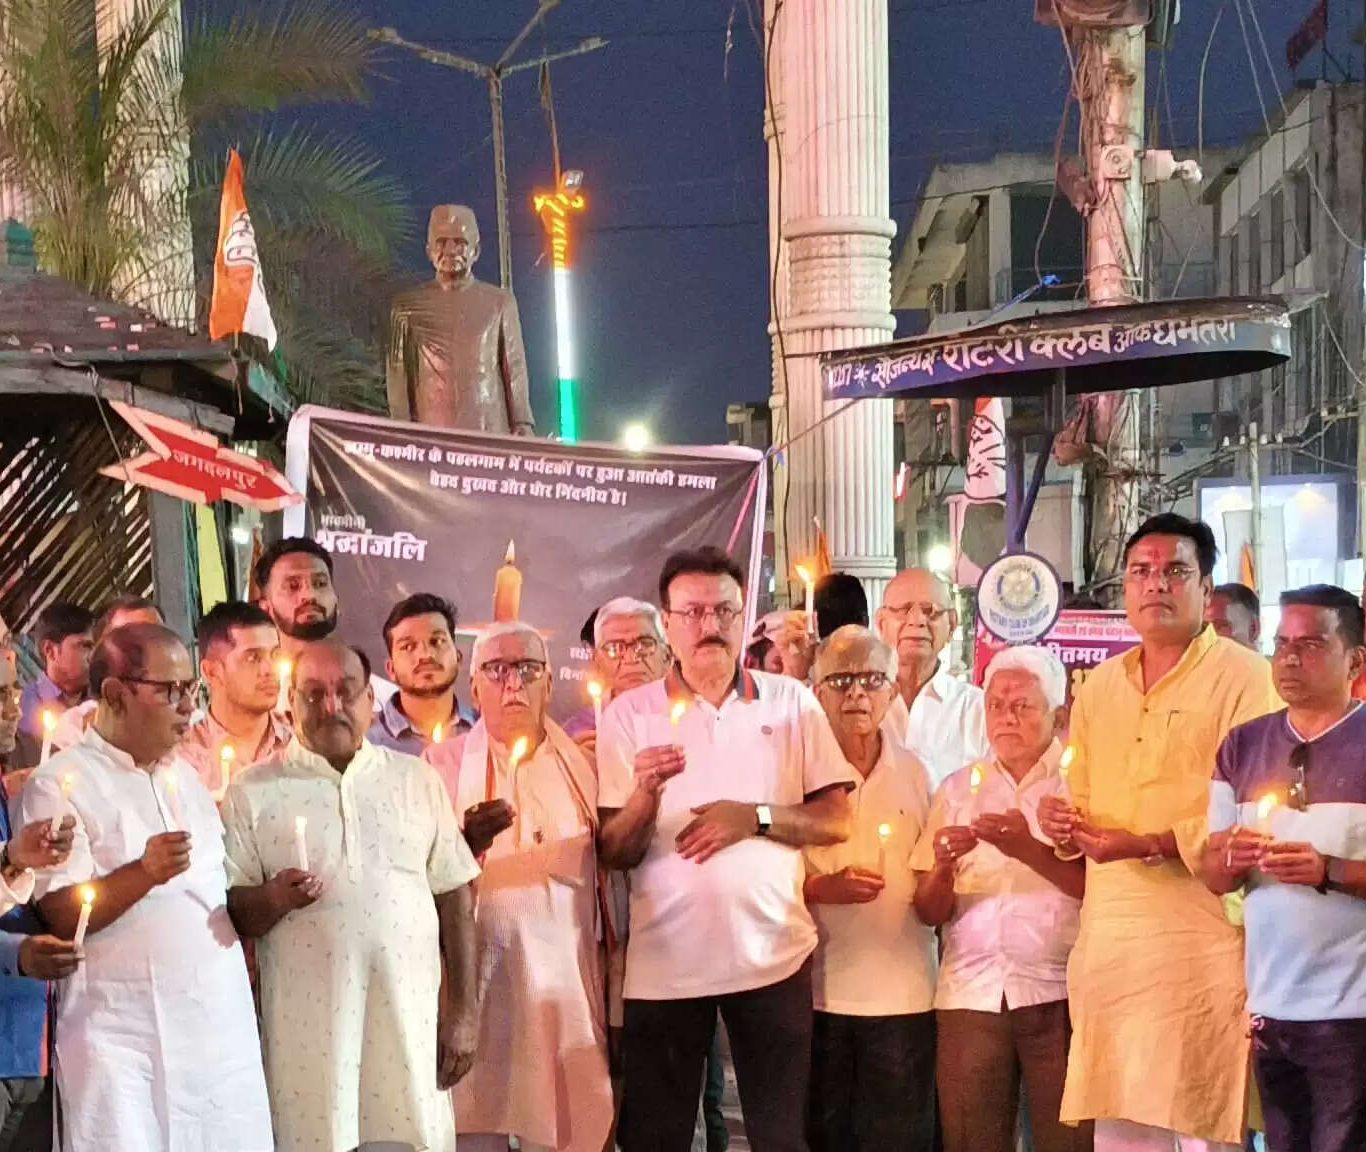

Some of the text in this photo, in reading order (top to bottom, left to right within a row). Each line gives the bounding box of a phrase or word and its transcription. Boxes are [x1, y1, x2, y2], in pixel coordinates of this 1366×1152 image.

[942, 324, 1025, 372] रोटरी
[1030, 322, 1113, 361] क्लब
[173, 451, 257, 490] जगदलपुर
[427, 446, 443, 464] के
[446, 450, 506, 471] पहलगाम
[508, 453, 522, 471] में
[523, 456, 575, 477] पर्यटकों
[576, 463, 595, 480] पर
[595, 465, 625, 484] हुआ
[627, 467, 676, 487] आतंकी
[678, 473, 718, 490] हमला
[429, 470, 460, 488] बेहद
[500, 477, 527, 496] और
[529, 480, 554, 498] घोर
[555, 482, 609, 504] निंदनीय
